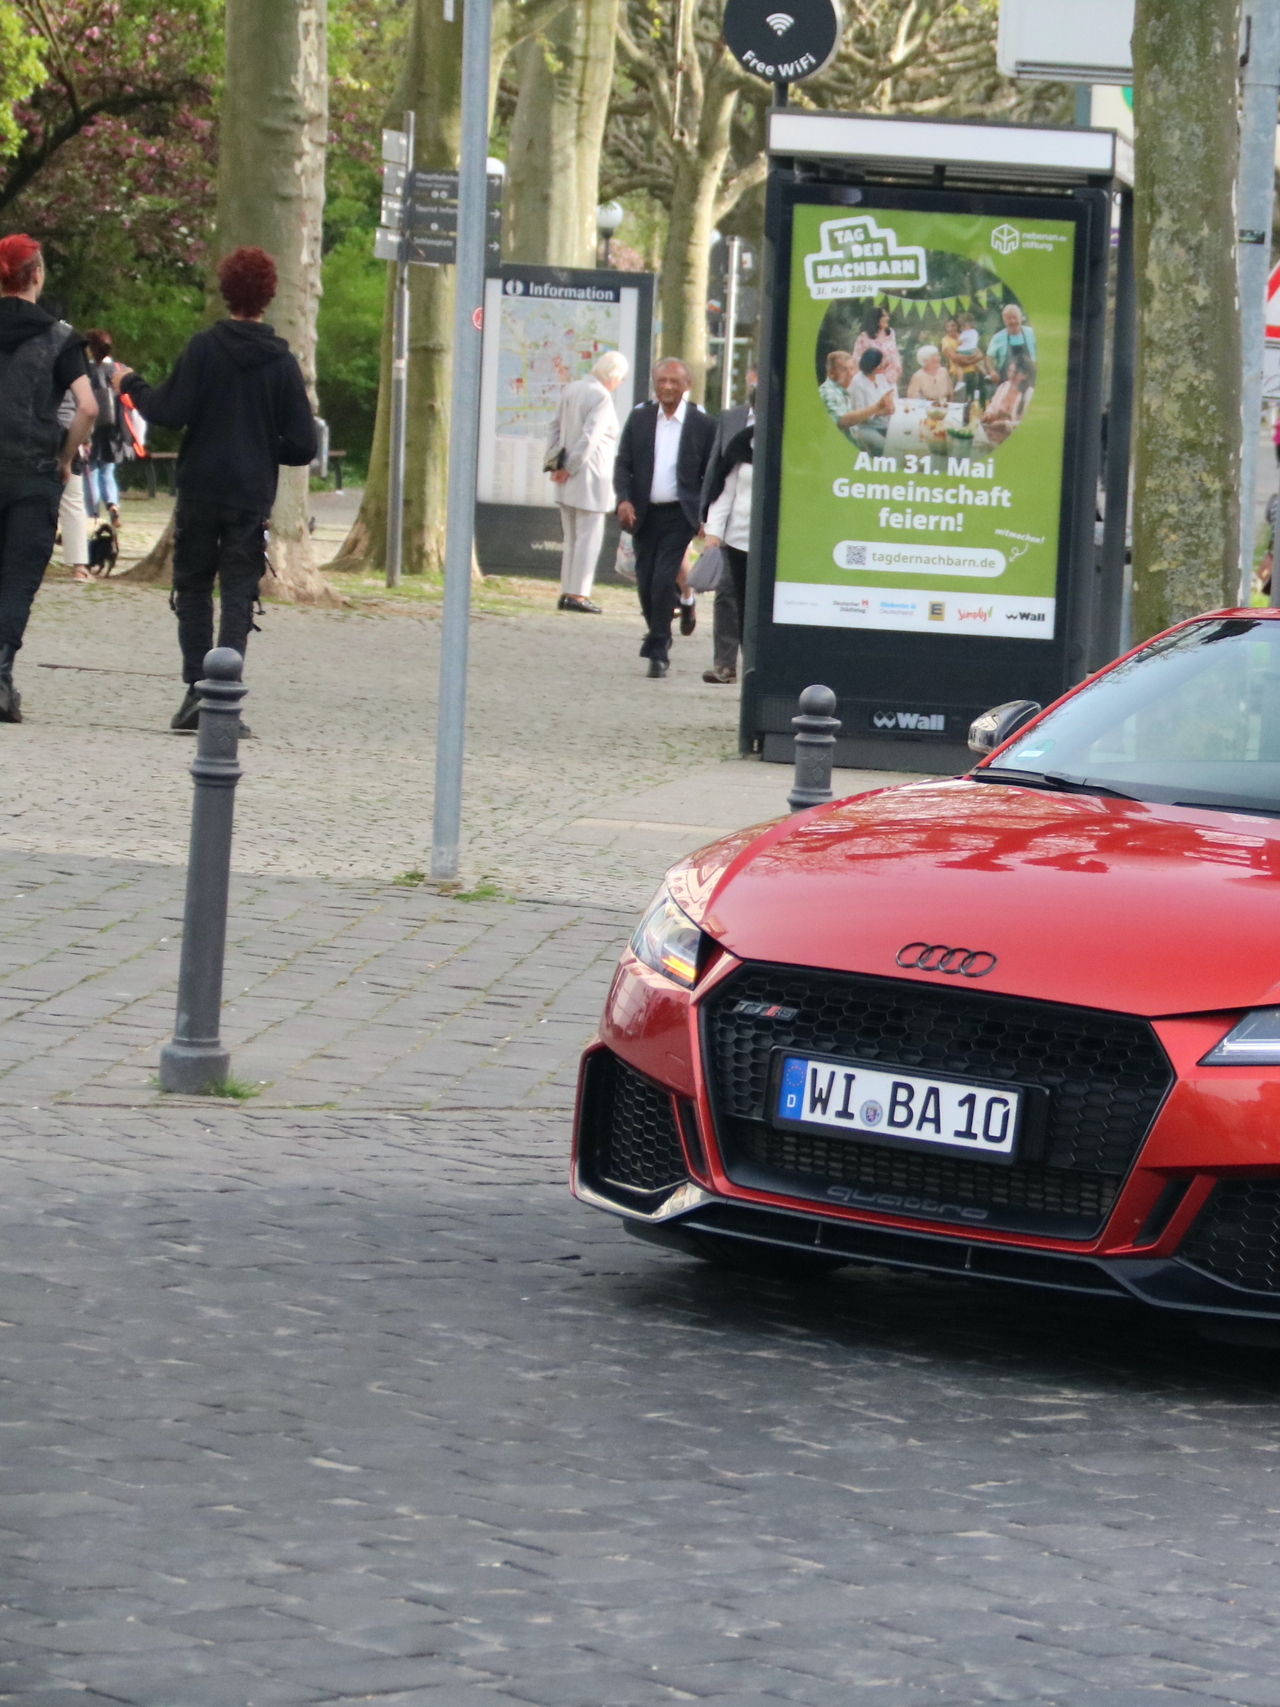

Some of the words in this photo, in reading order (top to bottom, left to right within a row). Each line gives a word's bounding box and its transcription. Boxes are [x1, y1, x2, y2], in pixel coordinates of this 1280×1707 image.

[742, 49, 775, 76] Free
[778, 52, 817, 77] WiFi
[415, 172, 459, 182] Hauptbahnh
[833, 227, 865, 244] TAG
[851, 242, 884, 258] DER
[816, 259, 916, 279] NACHBARN
[529, 282, 614, 300] Information
[816, 286, 827, 295] 31.
[831, 285, 846, 294] Mai
[850, 284, 874, 294] 2024
[853, 451, 897, 473] Am
[903, 454, 940, 475] 31.
[947, 457, 994, 479] Mai
[832, 477, 1012, 507] Gemeinschaft
[878, 507, 964, 532] feiern!
[994, 528, 1046, 544] mitmachen!
[872, 552, 996, 569] tagdernachbarn.de
[1019, 611, 1045, 622] Wall
[896, 712, 945, 731] Wall
[737, 1000, 771, 1014] TT
[786, 1095, 796, 1108] D
[809, 1067, 856, 1121] WI
[887, 1081, 942, 1134] BA
[953, 1092, 1010, 1144] 10
[827, 1185, 989, 1220] quattro
